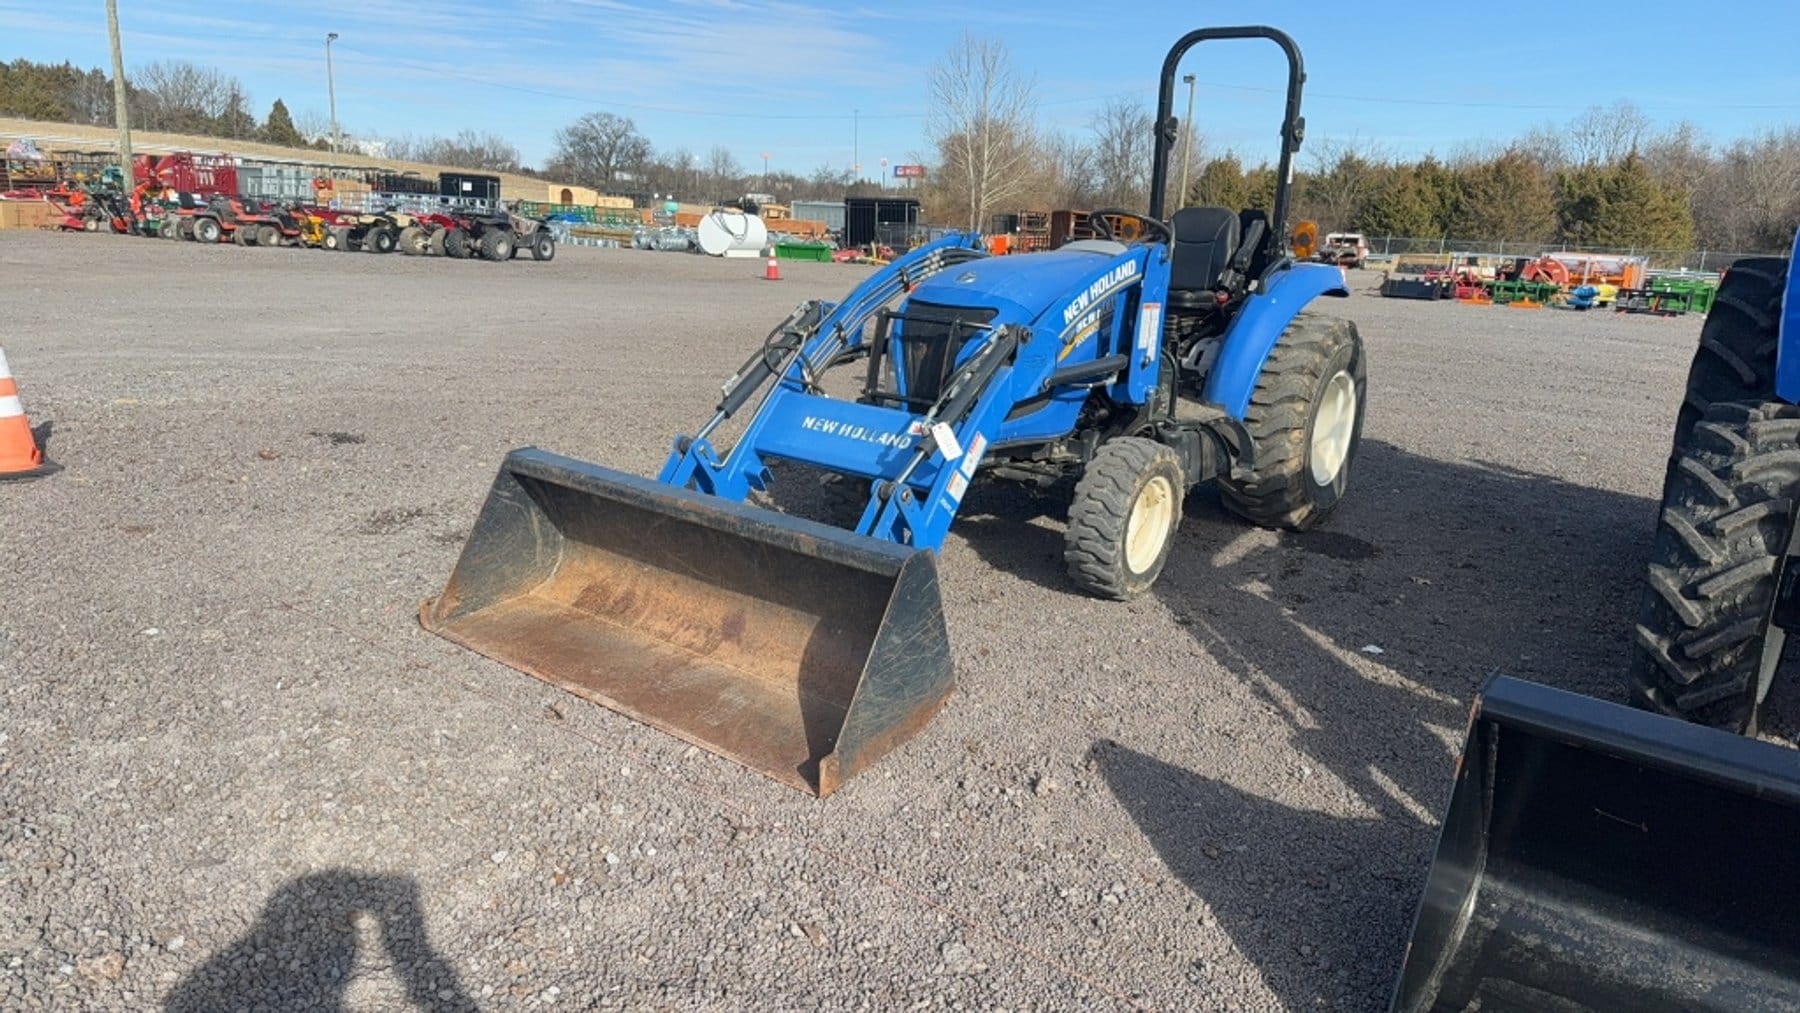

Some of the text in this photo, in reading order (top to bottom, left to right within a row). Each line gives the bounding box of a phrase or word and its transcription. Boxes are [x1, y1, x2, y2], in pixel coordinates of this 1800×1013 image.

[1063, 290, 1089, 324] NEW
[1089, 259, 1137, 299] HOLLAND
[801, 415, 839, 434] NEW
[838, 423, 912, 449] HOLLAND
